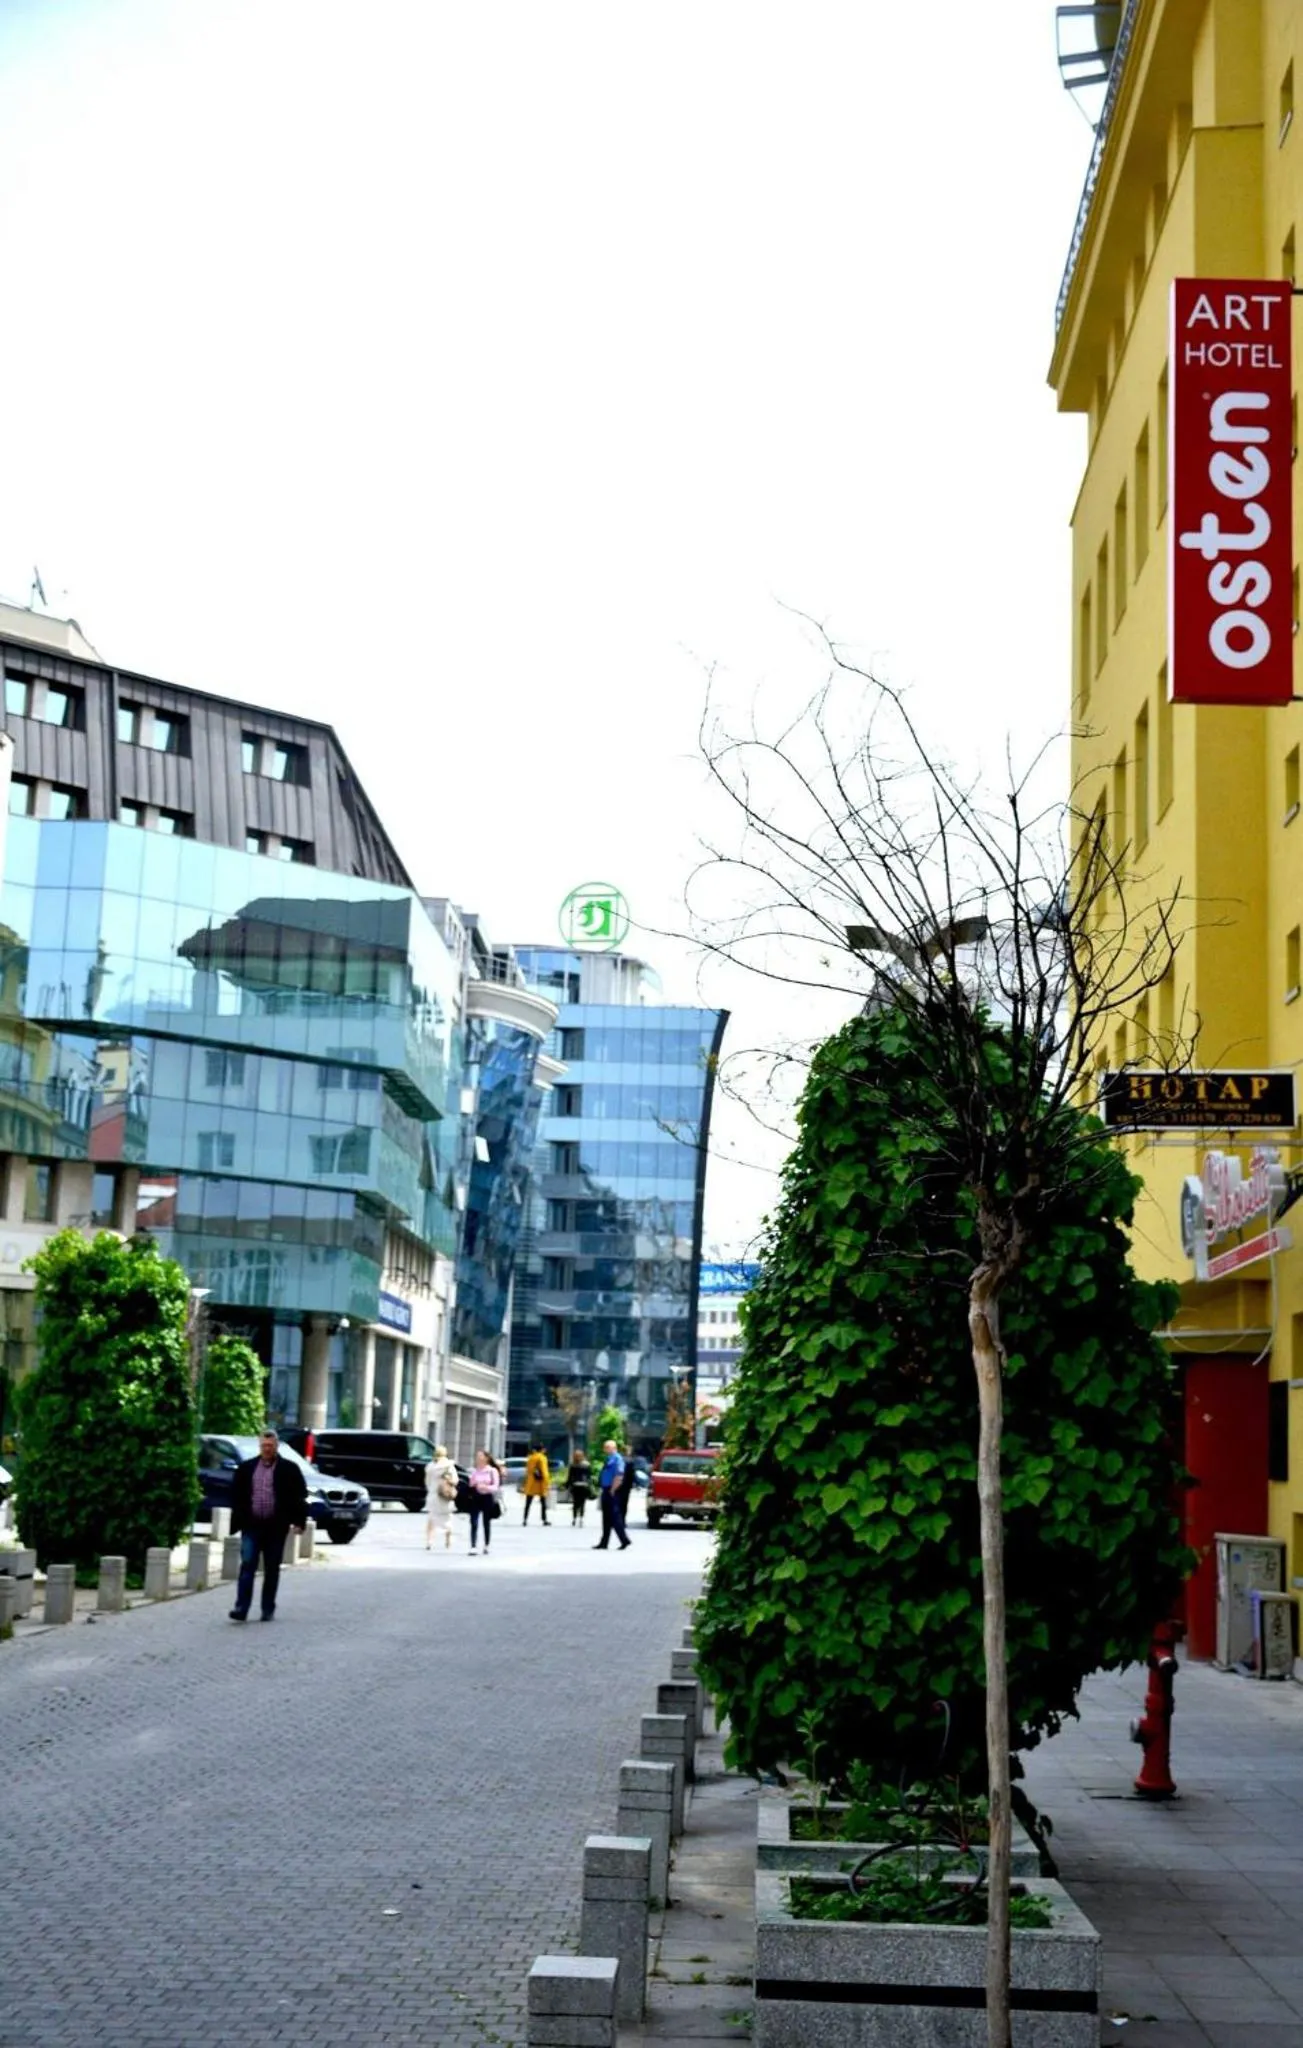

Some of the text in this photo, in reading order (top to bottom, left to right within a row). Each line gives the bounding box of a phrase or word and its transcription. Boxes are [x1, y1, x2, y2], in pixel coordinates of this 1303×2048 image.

[1186, 295, 1281, 330] ART
[1185, 342, 1282, 368] HOTEL
[1179, 391, 1271, 669] osten
